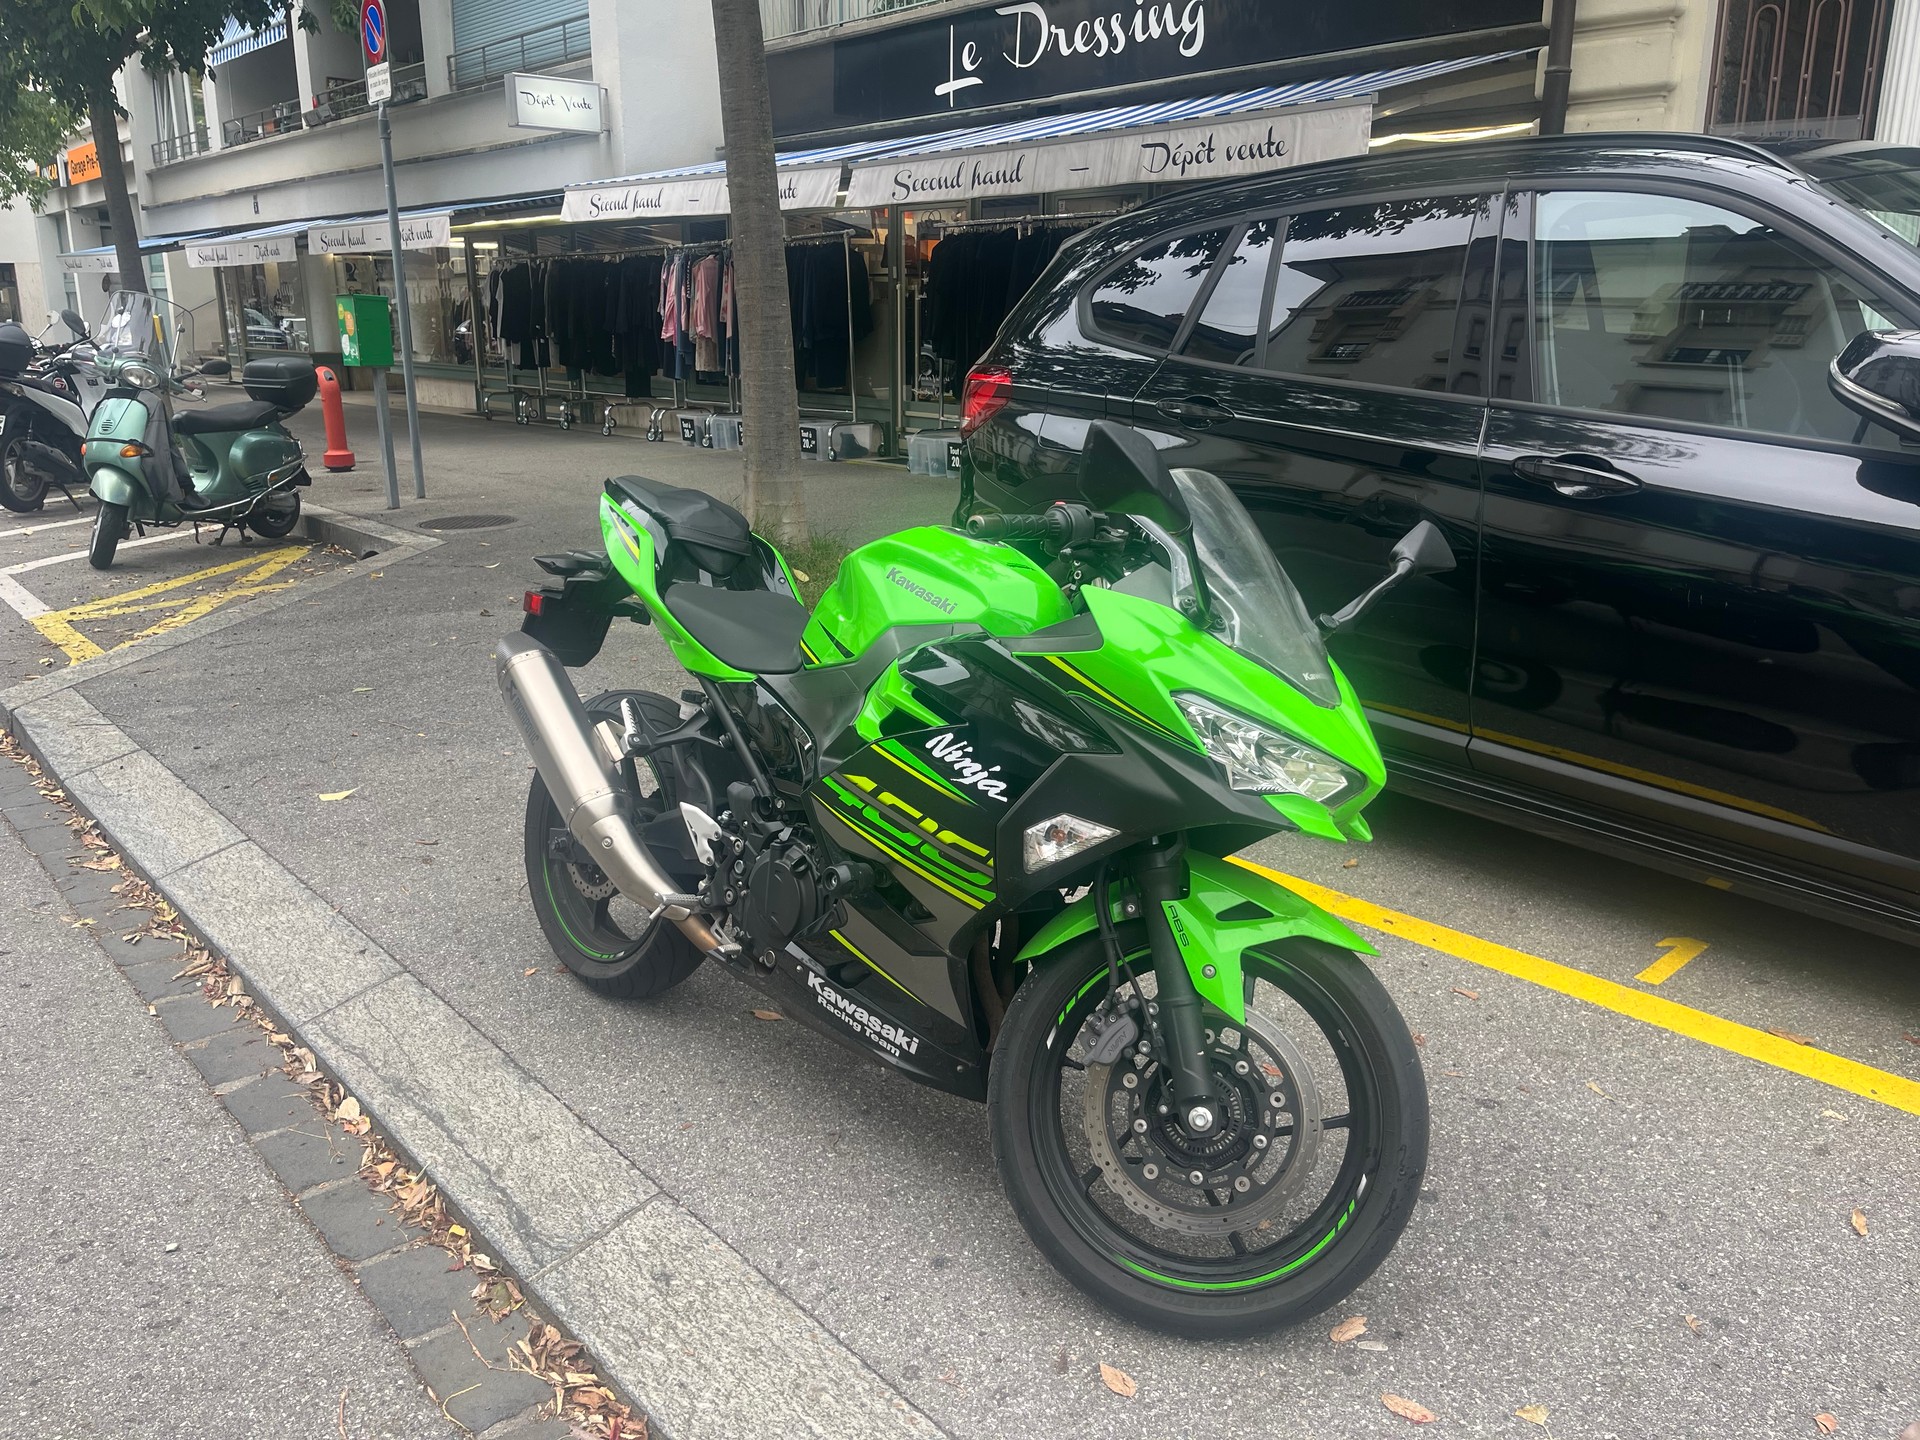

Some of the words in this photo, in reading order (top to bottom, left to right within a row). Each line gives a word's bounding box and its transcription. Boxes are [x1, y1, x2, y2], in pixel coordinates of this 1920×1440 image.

[934, 24, 983, 108] Le
[995, 0, 1204, 68] Dressing
[520, 90, 555, 108] Dépôt
[561, 95, 593, 112] Vente
[892, 161, 966, 201] Second
[970, 155, 1025, 190] hand
[1141, 138, 1215, 176] Dépôt
[1226, 126, 1290, 161] vente
[589, 190, 629, 218] Second
[633, 187, 664, 213] hand
[320, 229, 347, 252] Second
[347, 227, 367, 248] hand
[400, 224, 415, 248] épôt
[949, 446, 959, 455] Tout
[886, 567, 958, 615] Kawasaki
[925, 732, 1008, 803] Ninja
[1168, 905, 1190, 947] ABS
[807, 970, 919, 1055] Kawasaki
[817, 994, 862, 1033] Racing
[864, 1025, 901, 1057] Team
